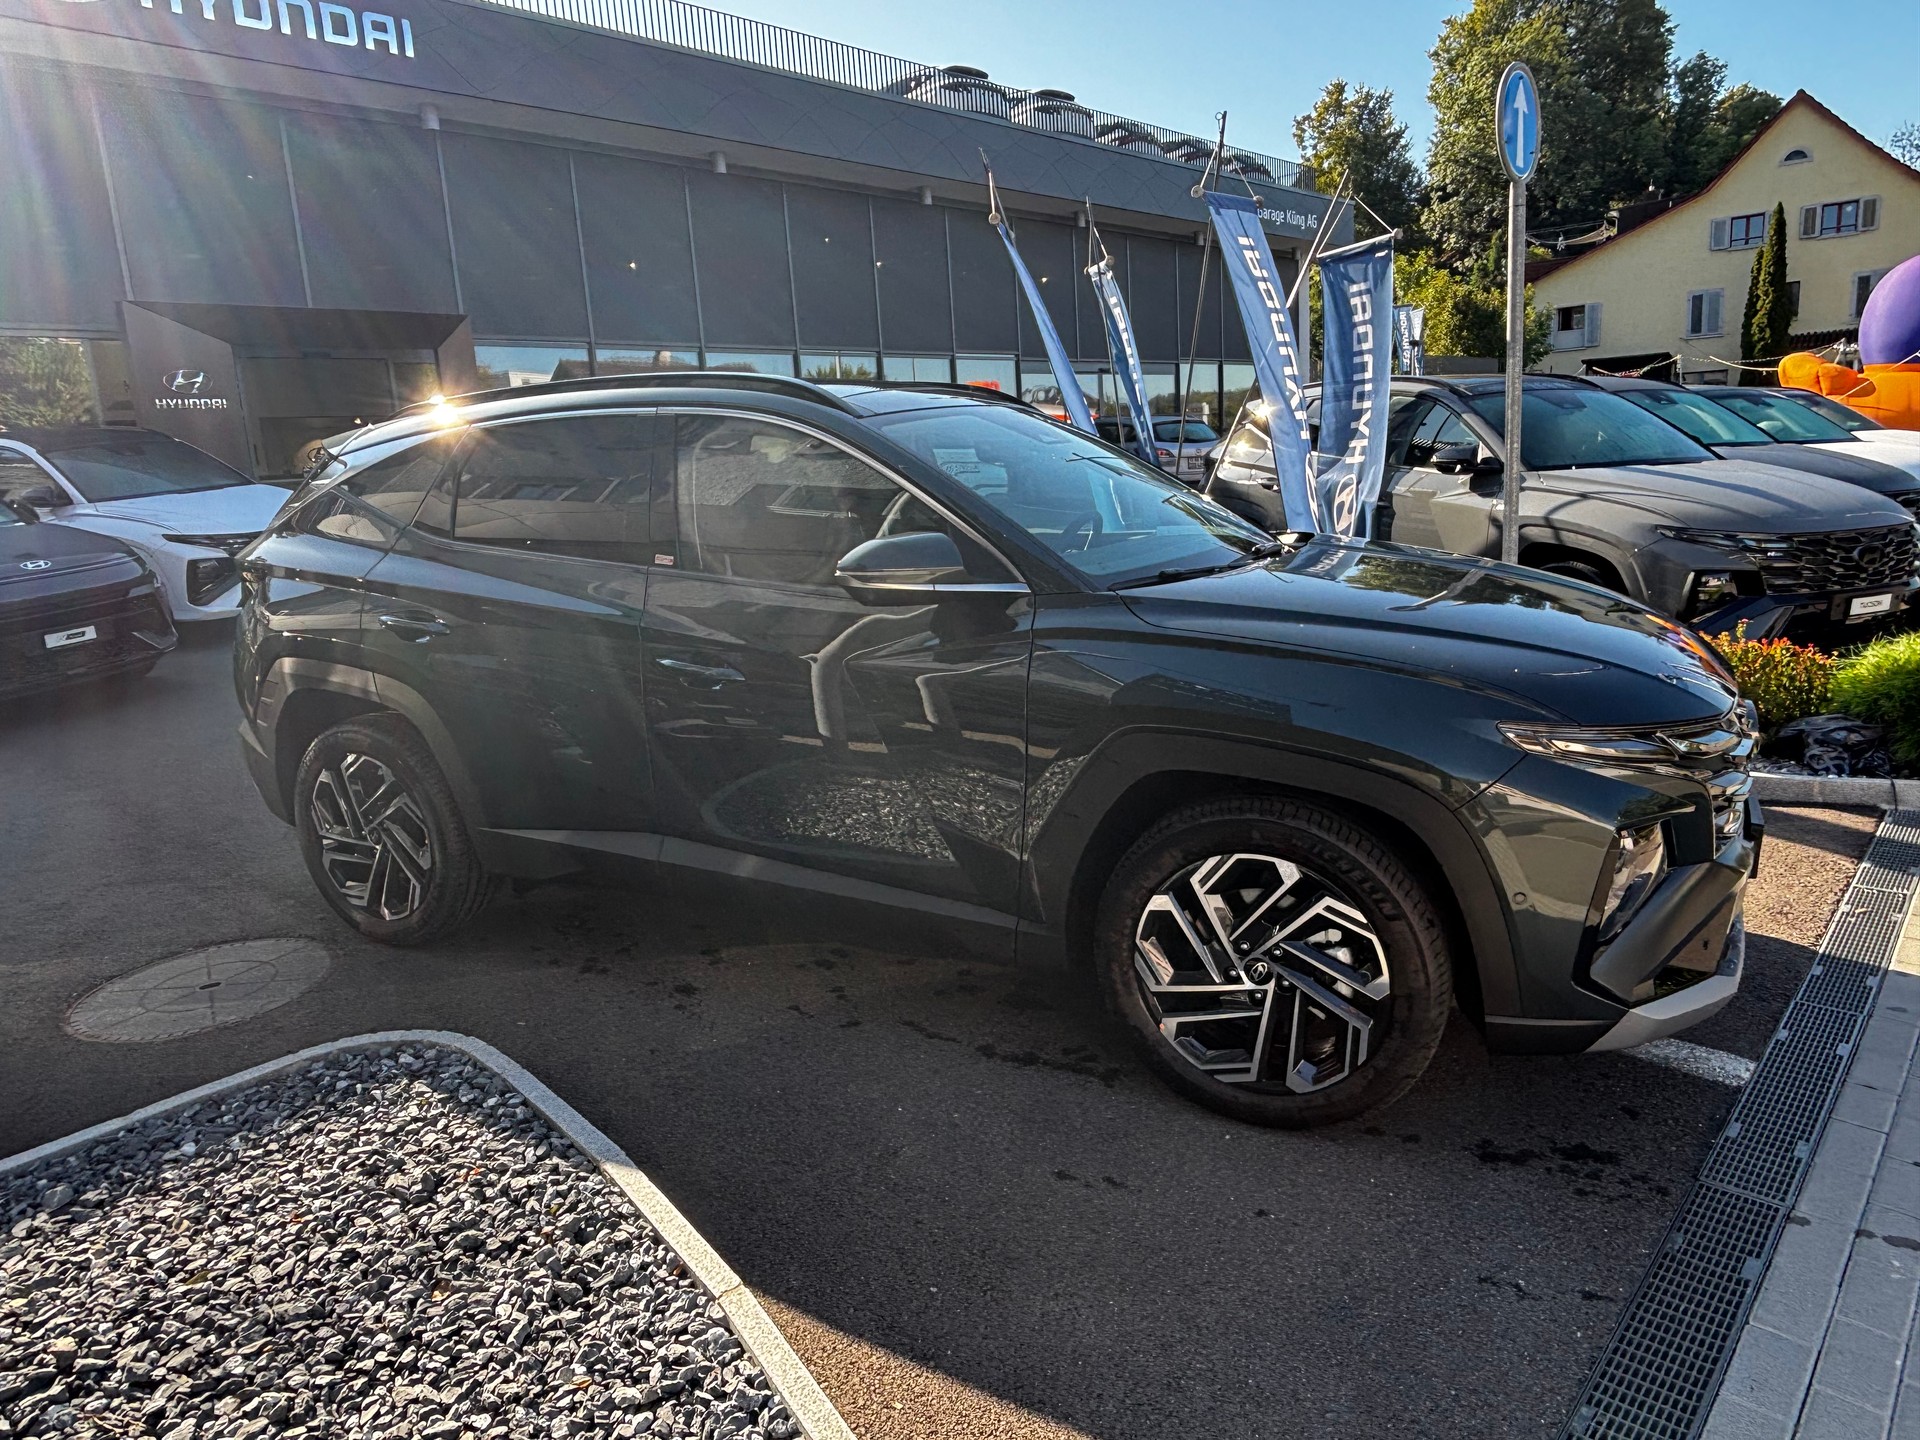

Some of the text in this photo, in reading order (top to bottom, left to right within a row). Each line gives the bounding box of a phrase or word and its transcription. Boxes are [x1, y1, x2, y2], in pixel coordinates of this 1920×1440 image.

[140, 0, 415, 58] YUNDAI
[1286, 209, 1306, 230] Küng
[1307, 213, 1318, 229] AG
[1238, 236, 1310, 440] HYUNDAI
[155, 398, 227, 410] HYUNDAI
